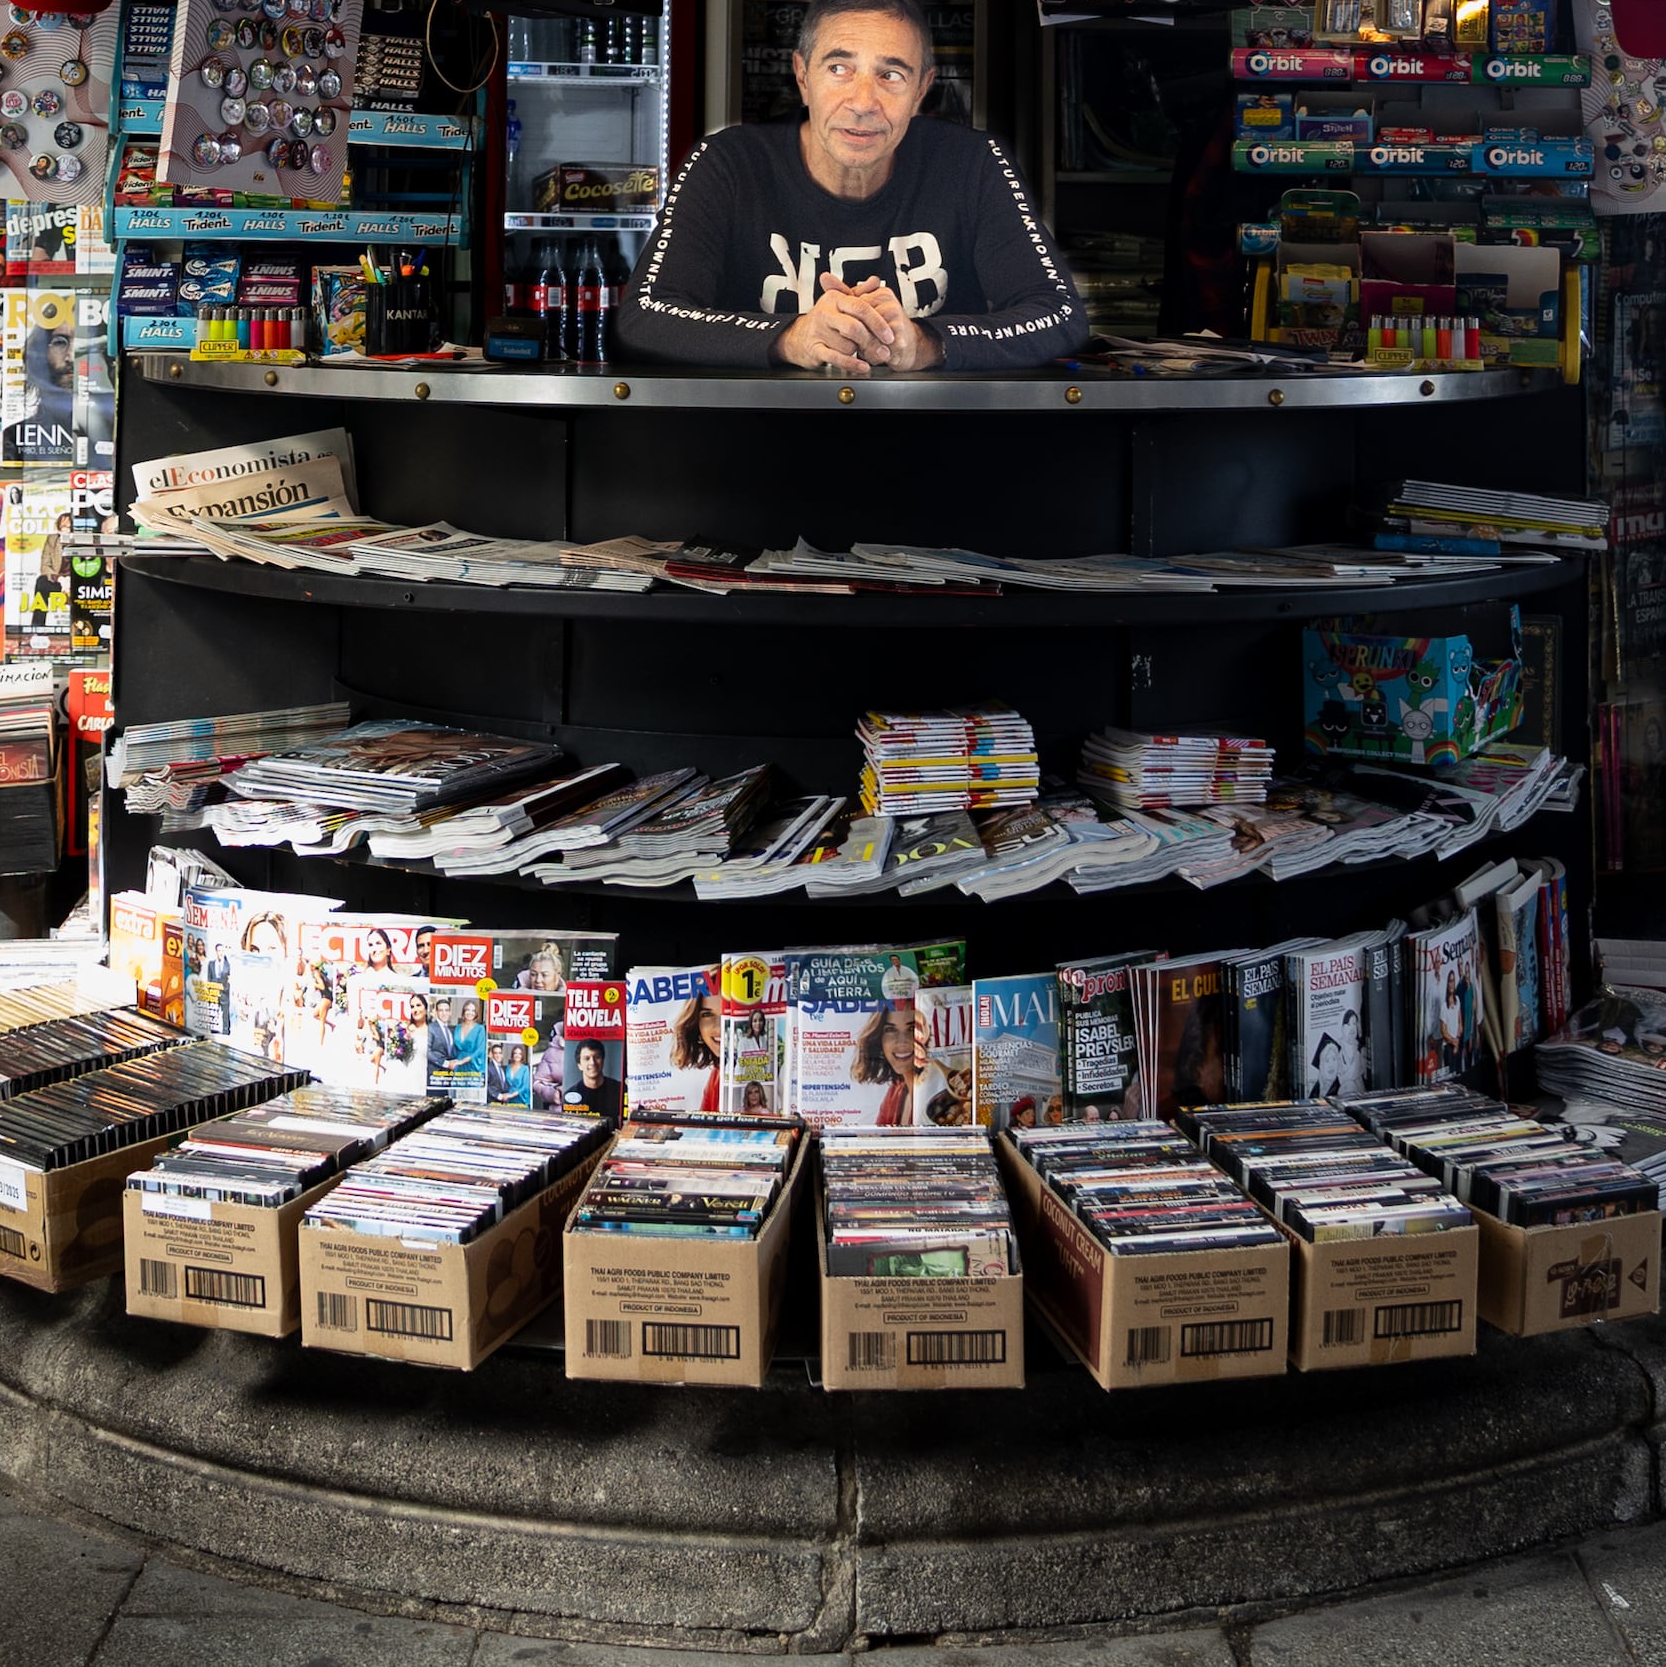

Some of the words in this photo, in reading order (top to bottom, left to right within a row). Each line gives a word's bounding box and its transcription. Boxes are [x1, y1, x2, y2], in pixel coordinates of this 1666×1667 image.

[1250, 53, 1302, 72] Orbit
[1370, 57, 1423, 76] Orbit
[1487, 60, 1541, 79] Orbit
[371, 101, 414, 112] HALLS
[384, 123, 426, 135] HALLS
[1251, 146, 1304, 165] Orbit
[1371, 146, 1424, 165] Orbit
[1490, 148, 1544, 167] Orbit
[564, 171, 658, 203] Cocosette
[129, 218, 171, 229] HALLS
[183, 219, 231, 231] Trident
[243, 220, 286, 231] HALLS
[297, 221, 345, 233] Trident
[357, 222, 400, 234] HALLS
[411, 224, 458, 236] Trident
[386, 308, 429, 321] KANTAR
[140, 326, 183, 338] HALLS
[202, 341, 237, 352] CLIPPER
[1376, 350, 1412, 363] CLIPPER
[166, 477, 310, 520] Expansión
[1333, 646, 1415, 670] SPRUNKI
[435, 943, 487, 968] DIEZ
[435, 965, 487, 980] MINUTOS
[566, 987, 600, 1010] TELE
[489, 999, 532, 1018] DIEZ
[566, 1005, 623, 1030] NOVELA
[489, 1016, 532, 1029] MINUTOS
[1075, 1026, 1121, 1043] ISABEL
[1075, 1036, 1135, 1059] PREYSLER
